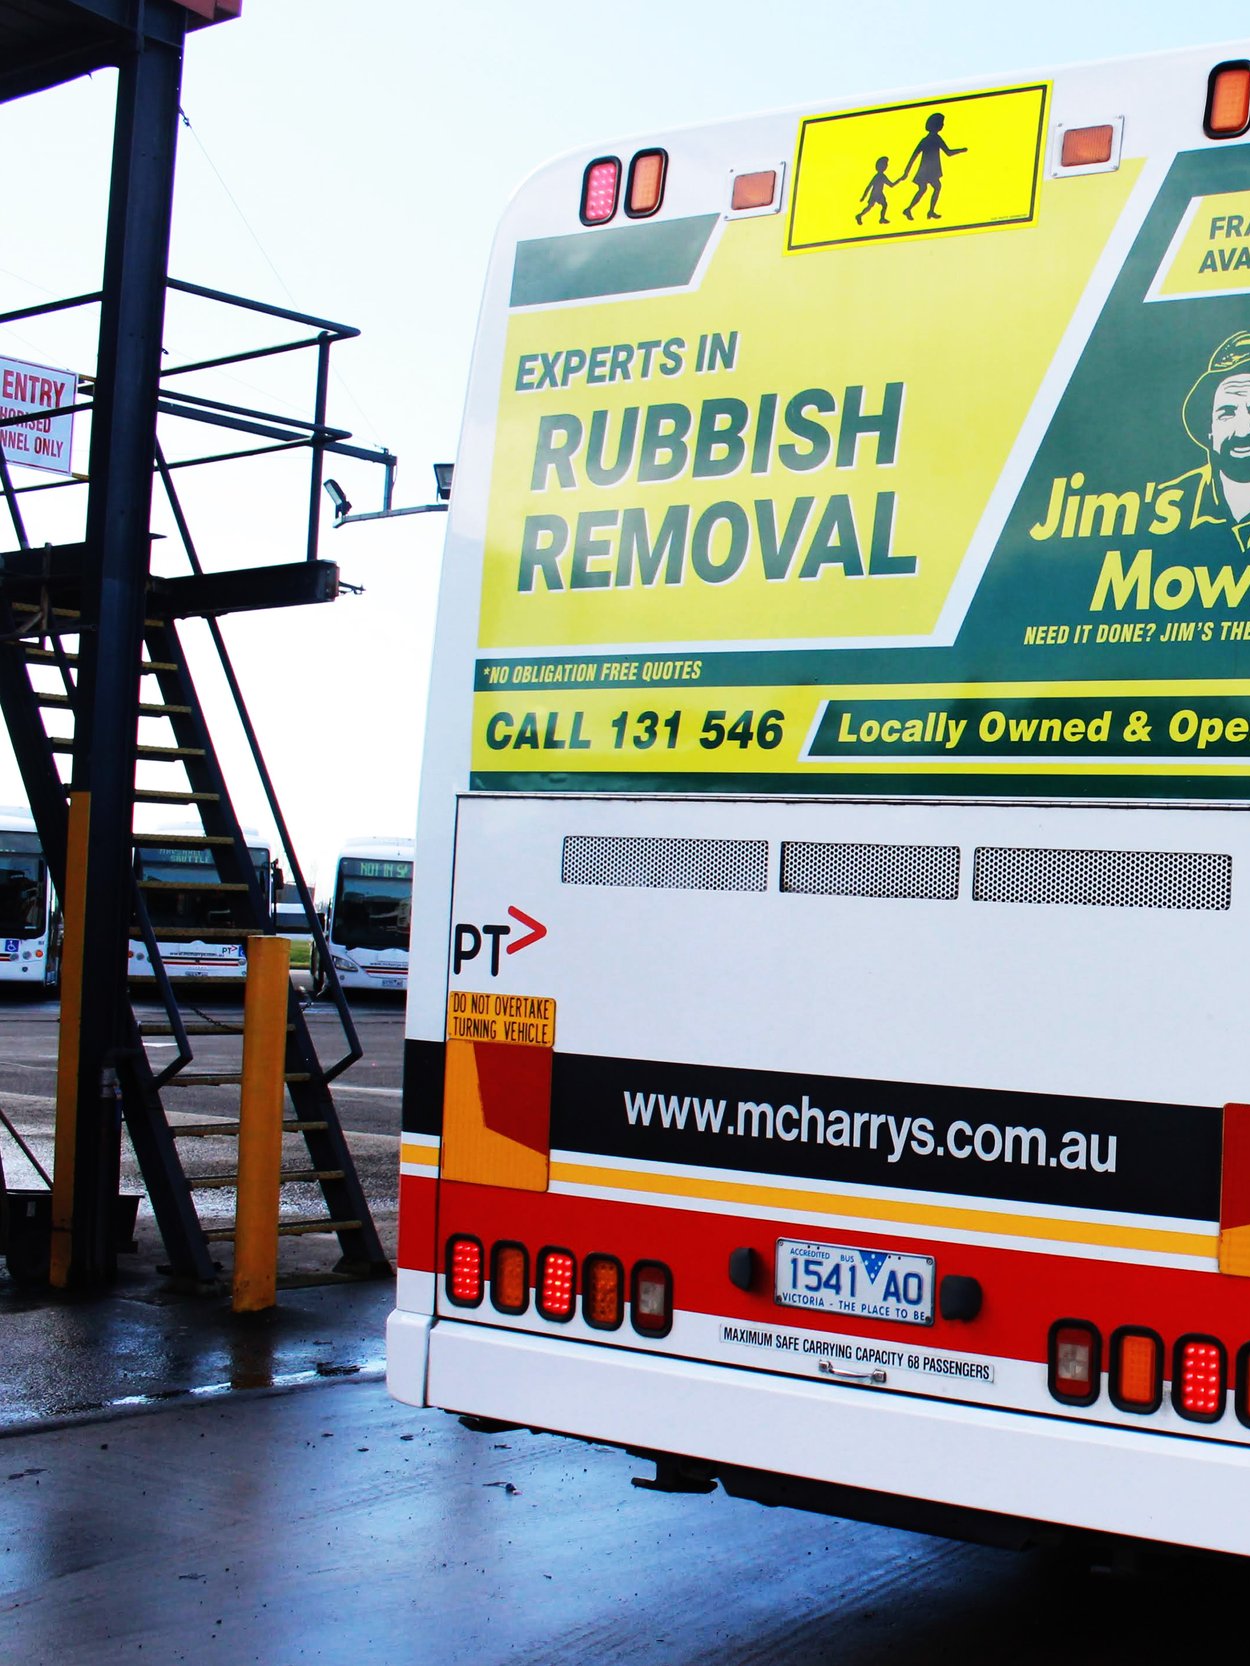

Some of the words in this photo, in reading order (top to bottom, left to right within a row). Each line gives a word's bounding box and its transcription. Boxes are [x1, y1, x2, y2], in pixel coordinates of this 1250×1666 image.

[515, 337, 686, 392] EXPERTS
[695, 331, 740, 373] IN
[2, 369, 66, 408] ENTRY
[34, 436, 64, 458] ONLY
[530, 381, 904, 492] RUBBISH
[1029, 472, 1185, 541] Jim's
[517, 491, 918, 593] REMOVAL
[1023, 626, 1070, 645] NEED
[1073, 625, 1092, 643] IT
[1096, 623, 1157, 643] DONE?
[1160, 621, 1213, 642] JIM'S
[512, 663, 598, 684] OBLIGATION
[600, 662, 639, 681] FREE
[642, 660, 702, 682] QUOTES
[485, 711, 593, 750] CALL
[610, 710, 690, 750] 131
[699, 709, 786, 749] 546
[838, 712, 967, 749] Locally
[978, 710, 1110, 742] Owned
[1122, 711, 1152, 741] &
[453, 993, 466, 1013] DO
[471, 994, 491, 1015] NOT
[494, 996, 549, 1020] OVERTAKE
[453, 1016, 497, 1040] TURNING
[503, 1020, 548, 1044] VEHICLE
[623, 1090, 1118, 1173] www.mcharrys.com.au
[790, 1247, 831, 1260] ACCREDITED
[840, 1254, 855, 1263] BUS
[791, 1257, 857, 1298] 1541
[782, 1292, 825, 1308] VICTORIA
[839, 1300, 856, 1312] THE
[861, 1303, 890, 1317] PLACE
[895, 1308, 908, 1319] TO
[913, 1311, 926, 1321] BE
[723, 1326, 773, 1348] MAXIMUM
[775, 1333, 800, 1351] SAFE
[803, 1338, 852, 1360] CARRYING
[855, 1345, 904, 1369] CAPACITY
[907, 1354, 920, 1370] 68
[923, 1356, 991, 1381] PASSENGERS
